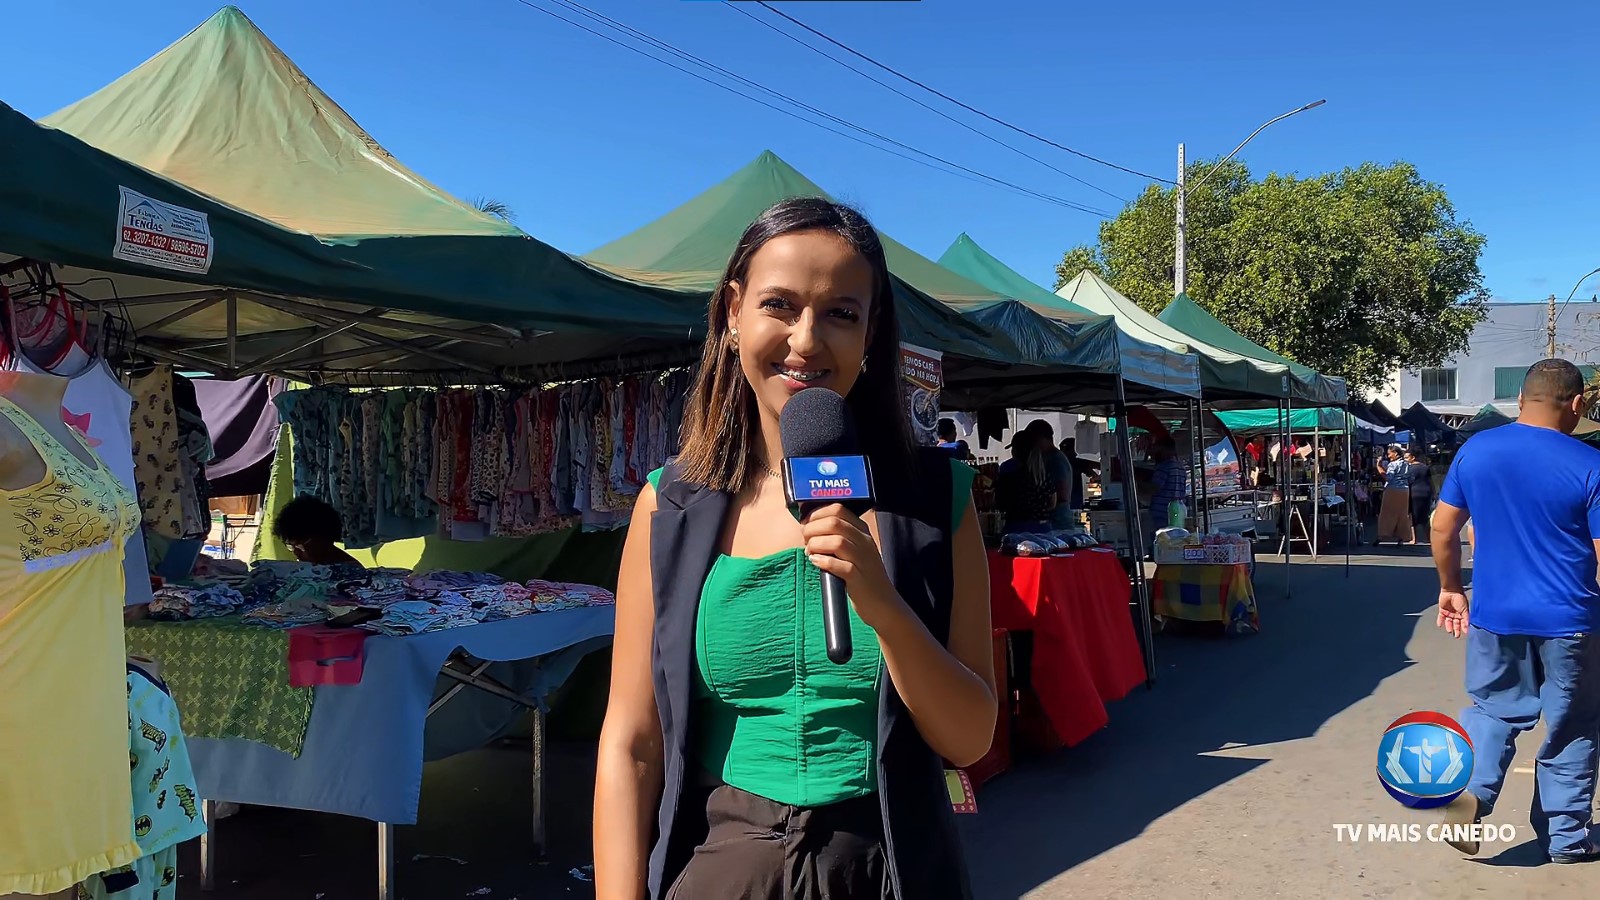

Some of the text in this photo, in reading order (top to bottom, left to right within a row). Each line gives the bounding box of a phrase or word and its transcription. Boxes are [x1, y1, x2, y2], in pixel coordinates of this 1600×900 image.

[904, 356, 934, 371] TEMOS CAFÉ
[926, 374, 940, 386] HORA
[809, 479, 850, 488] TV MAIS
[811, 488, 852, 497] CANEDO
